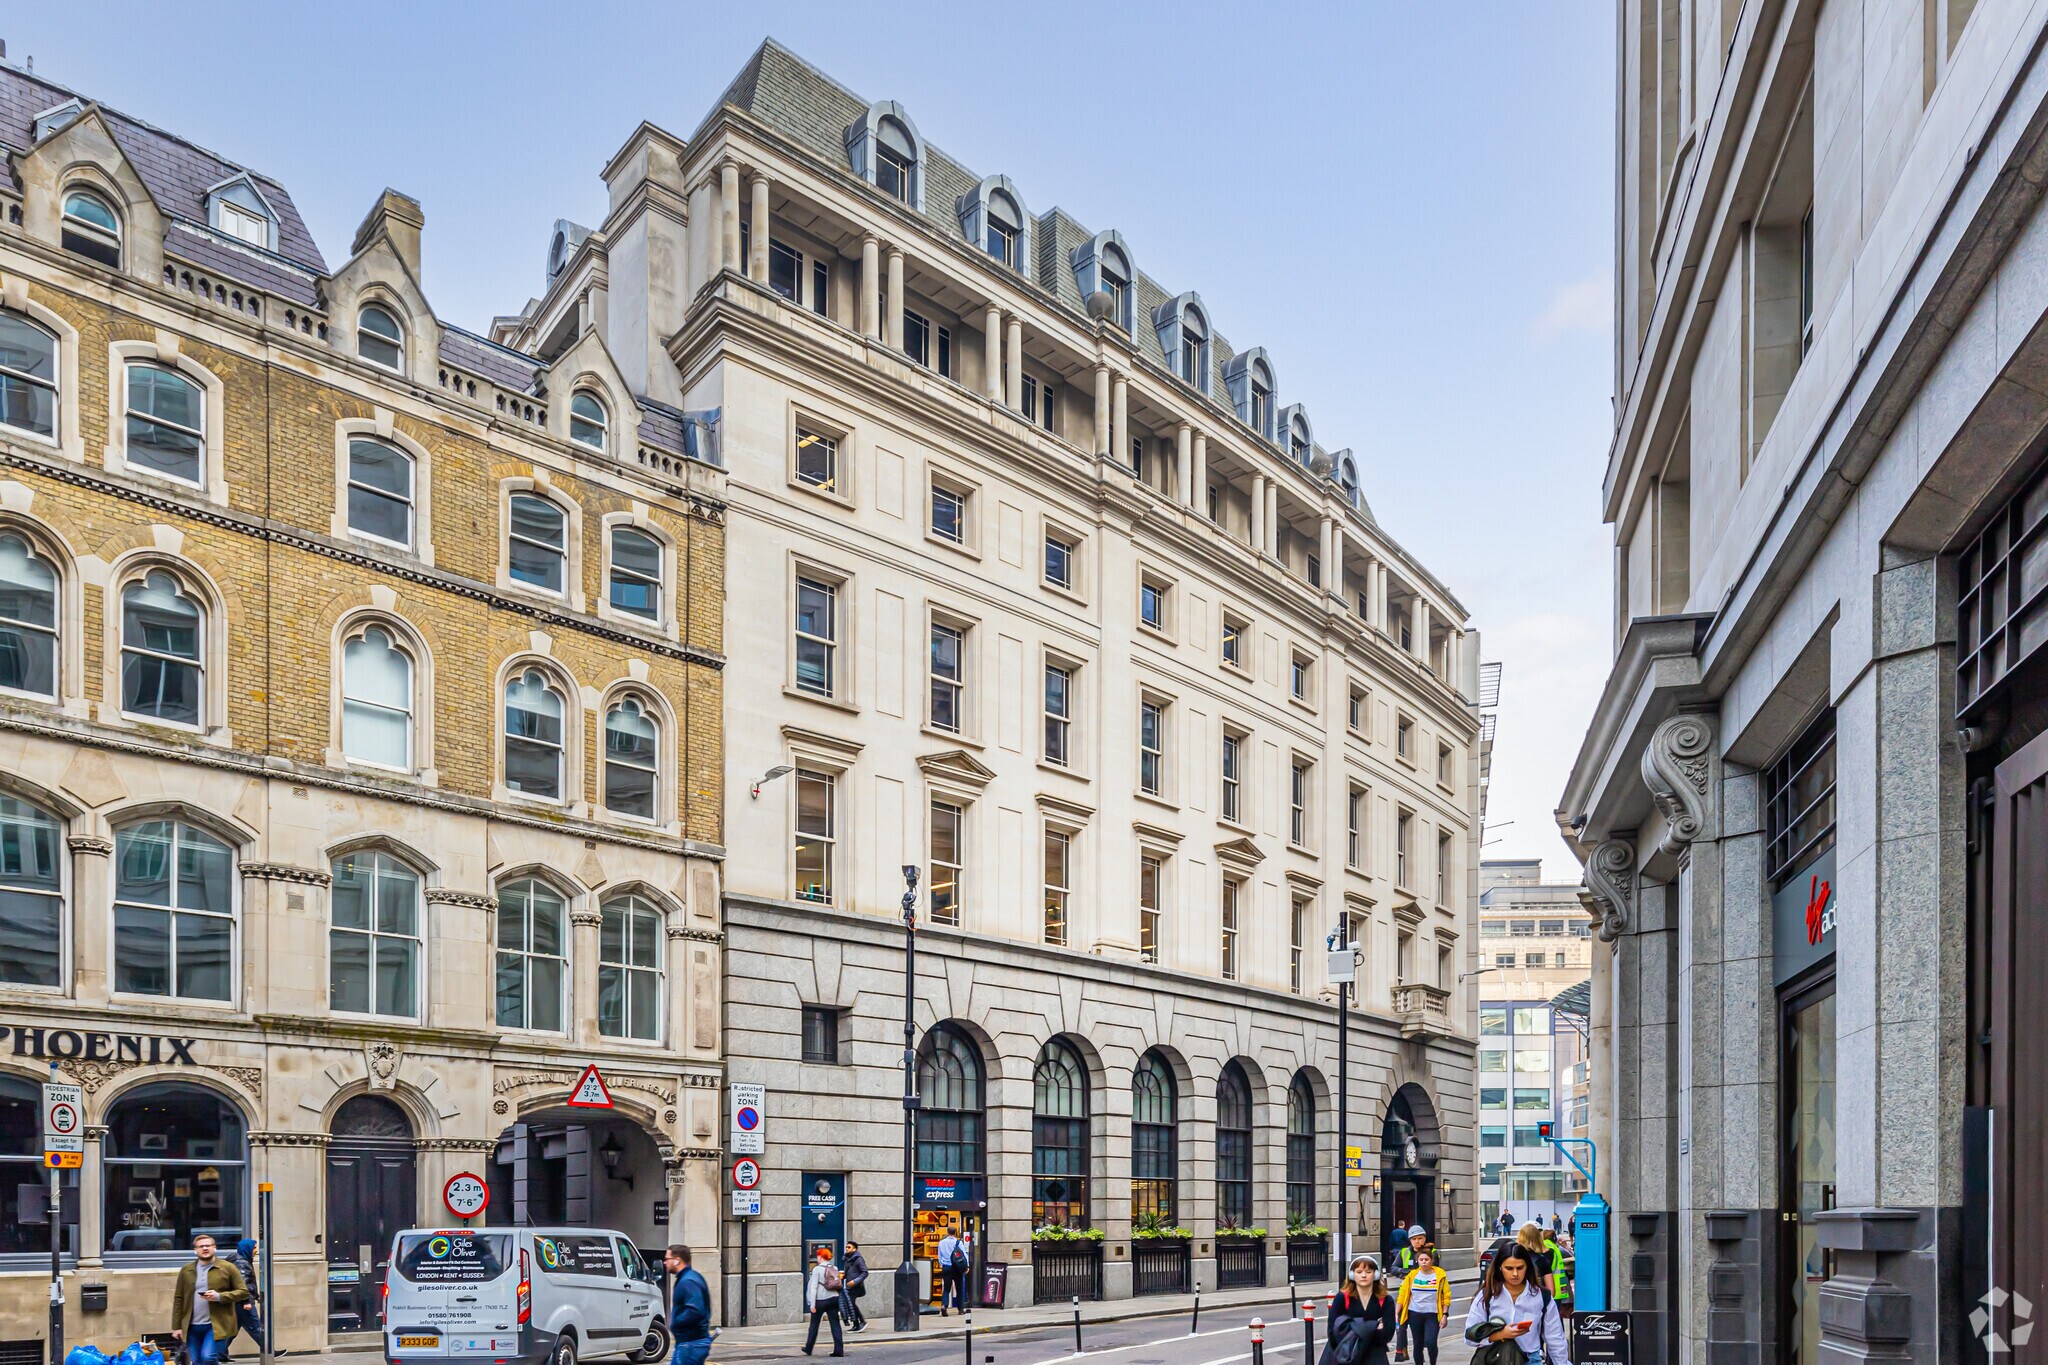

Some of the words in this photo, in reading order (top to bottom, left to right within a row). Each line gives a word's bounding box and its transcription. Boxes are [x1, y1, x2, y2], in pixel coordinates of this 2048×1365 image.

[50, 1093, 75, 1102] ZONE
[453, 1182, 471, 1192] 2.3
[925, 1178, 955, 1187] TESCO
[926, 1191, 954, 1200] express
[453, 1238, 472, 1248] Giles
[452, 1248, 476, 1257] Oliver
[557, 1242, 571, 1254] Giles
